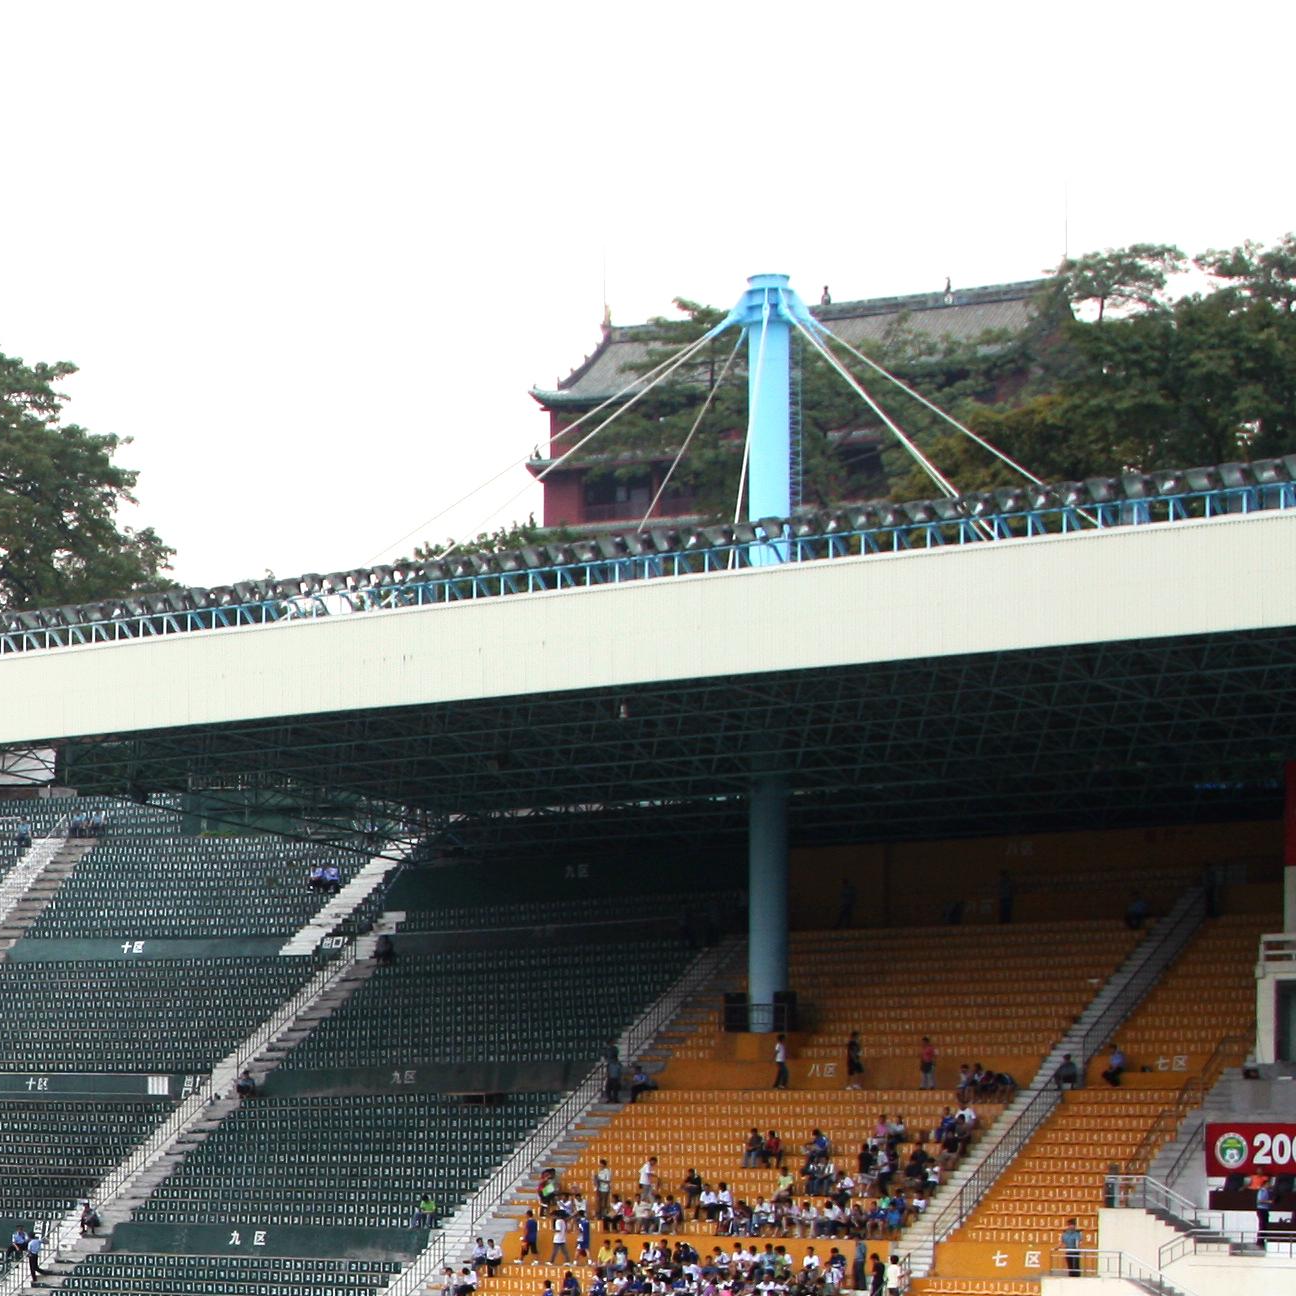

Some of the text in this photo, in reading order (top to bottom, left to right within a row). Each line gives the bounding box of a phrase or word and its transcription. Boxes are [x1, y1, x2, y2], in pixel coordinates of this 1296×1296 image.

[121, 941, 145, 955] 十区
[807, 1062, 838, 1078] 八区
[1156, 1055, 1187, 1071] 七区
[391, 1070, 417, 1085] 九区
[1252, 1132, 1296, 1165] 20
[228, 1230, 267, 1246] 九区
[991, 1250, 1042, 1268] 七区
